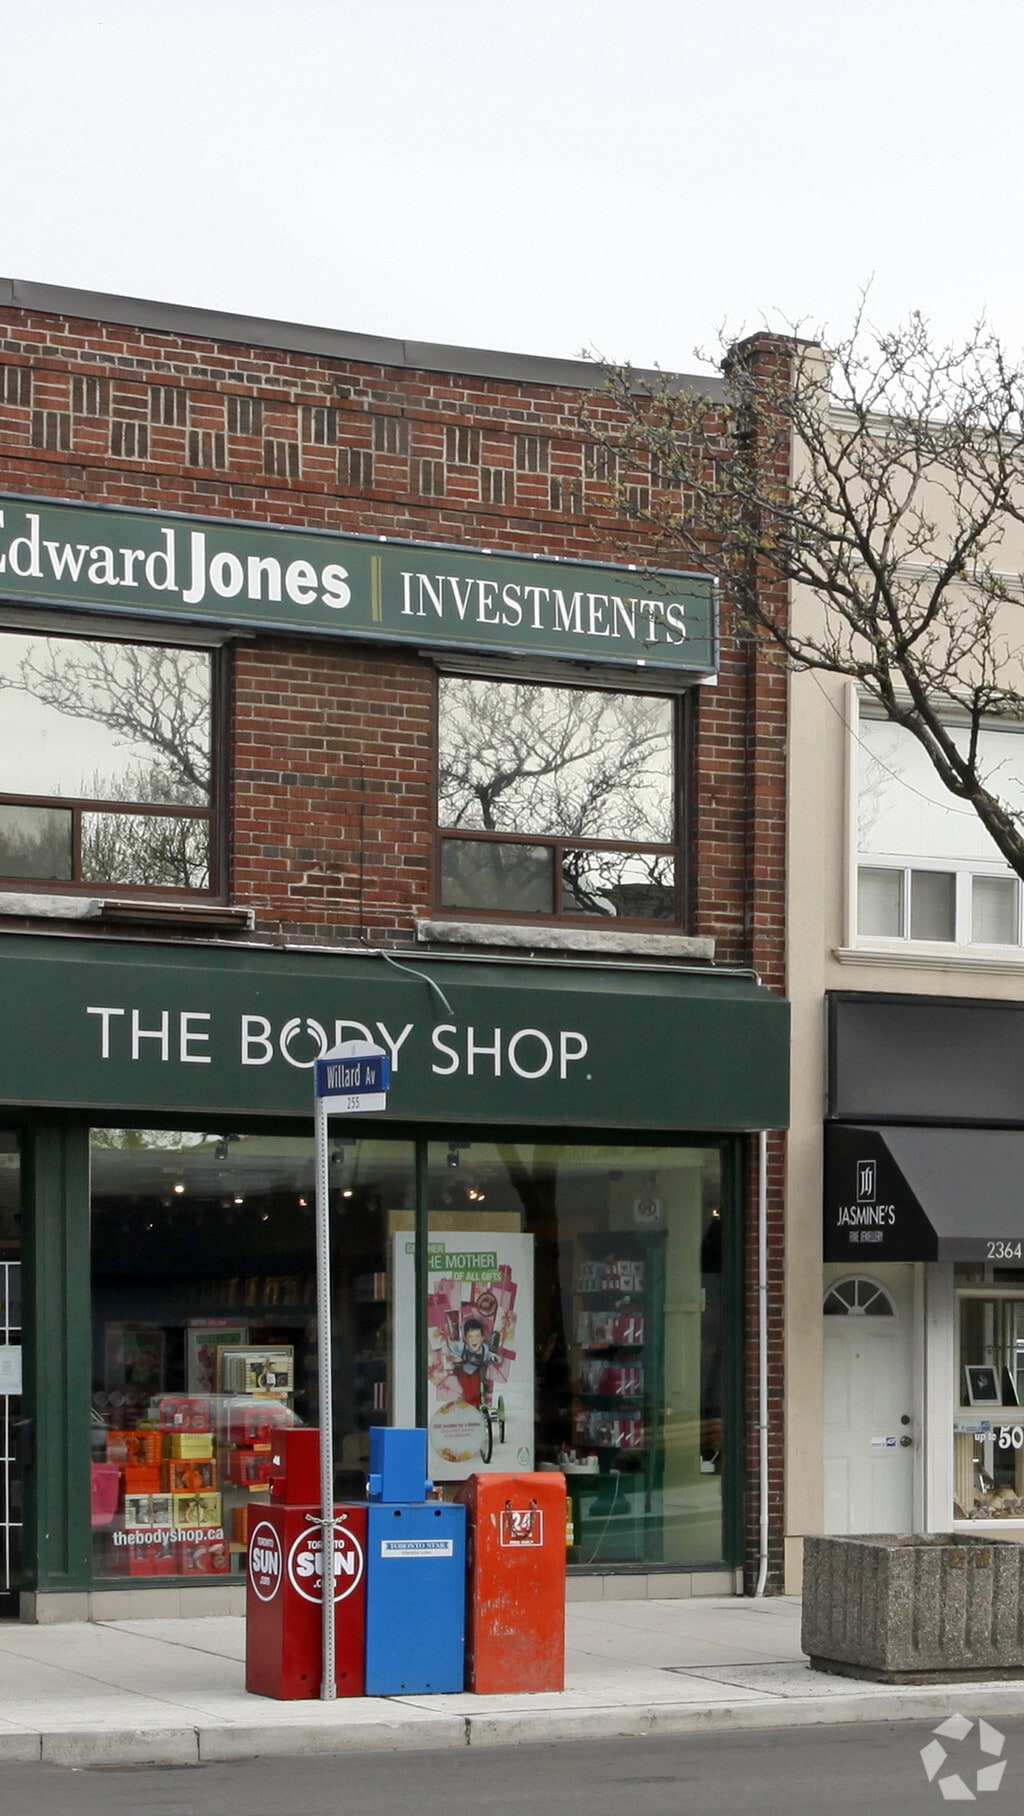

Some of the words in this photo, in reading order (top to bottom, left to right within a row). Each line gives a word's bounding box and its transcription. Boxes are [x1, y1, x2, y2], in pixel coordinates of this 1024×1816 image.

[400, 571, 688, 646] INVESTMENTS
[86, 1006, 212, 1064] THE
[431, 1024, 589, 1080] SHOP
[326, 1062, 361, 1089] Willard
[365, 1066, 376, 1085] Av
[347, 1096, 360, 1110] 255
[836, 1205, 896, 1227] JASMINE'S
[986, 1241, 1023, 1259] 2364
[445, 1254, 495, 1270] MOTHER
[453, 1272, 465, 1282] OF
[465, 1272, 480, 1282] ALL
[480, 1271, 502, 1281] GIFTS
[974, 1433, 985, 1443] up
[988, 1431, 996, 1441] to
[998, 1425, 1024, 1449] 50
[512, 1512, 532, 1531] 24
[112, 1527, 225, 1546] thebodyshop.ca
[306, 1539, 346, 1550] TORTO
[252, 1547, 279, 1576] SUN
